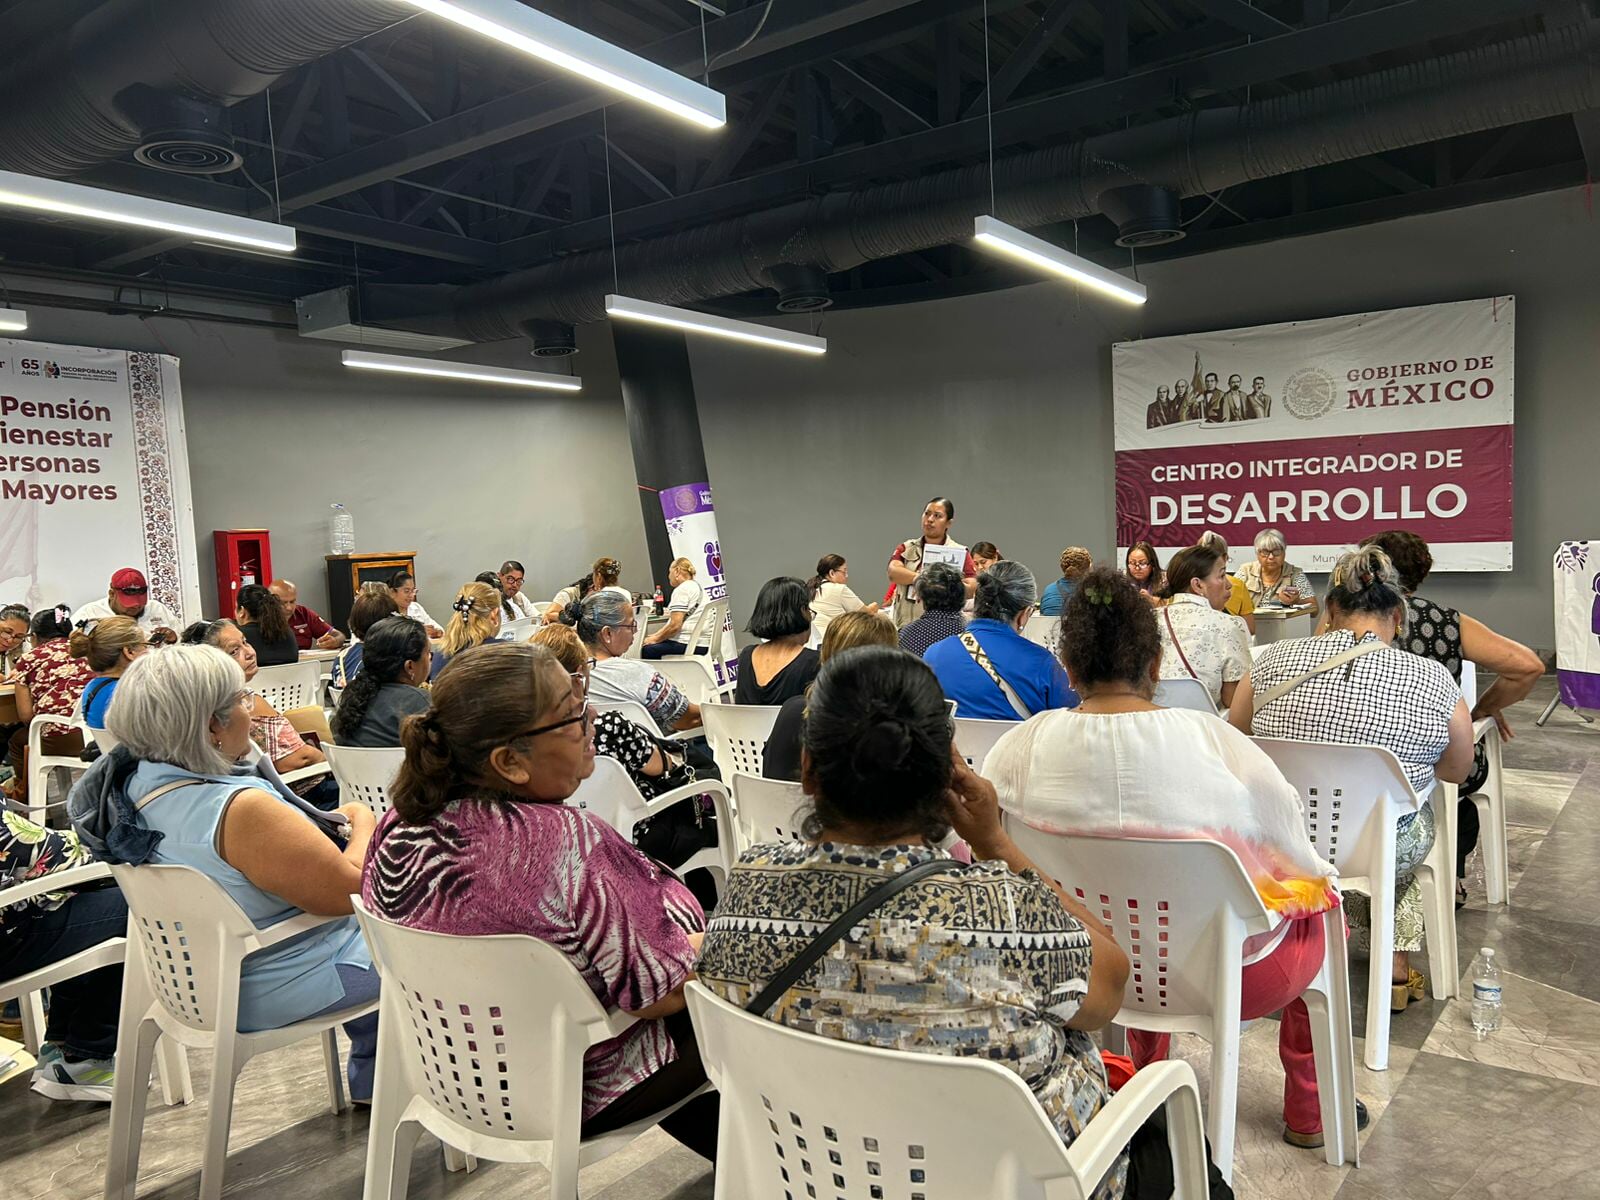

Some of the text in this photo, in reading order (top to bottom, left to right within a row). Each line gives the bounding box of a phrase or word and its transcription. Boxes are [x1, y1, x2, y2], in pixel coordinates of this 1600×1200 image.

[21, 358, 39, 370] 65
[60, 365, 118, 377] INCORPORACIÓN
[1346, 355, 1494, 382] GOBIERNO DE
[1346, 377, 1495, 409] MÉXICO
[0, 395, 111, 422] Pensión
[1151, 448, 1464, 483] CENTRO INTEGRADOR DE
[2, 479, 118, 505] Mayores
[1149, 483, 1468, 526] DESARROLLO
